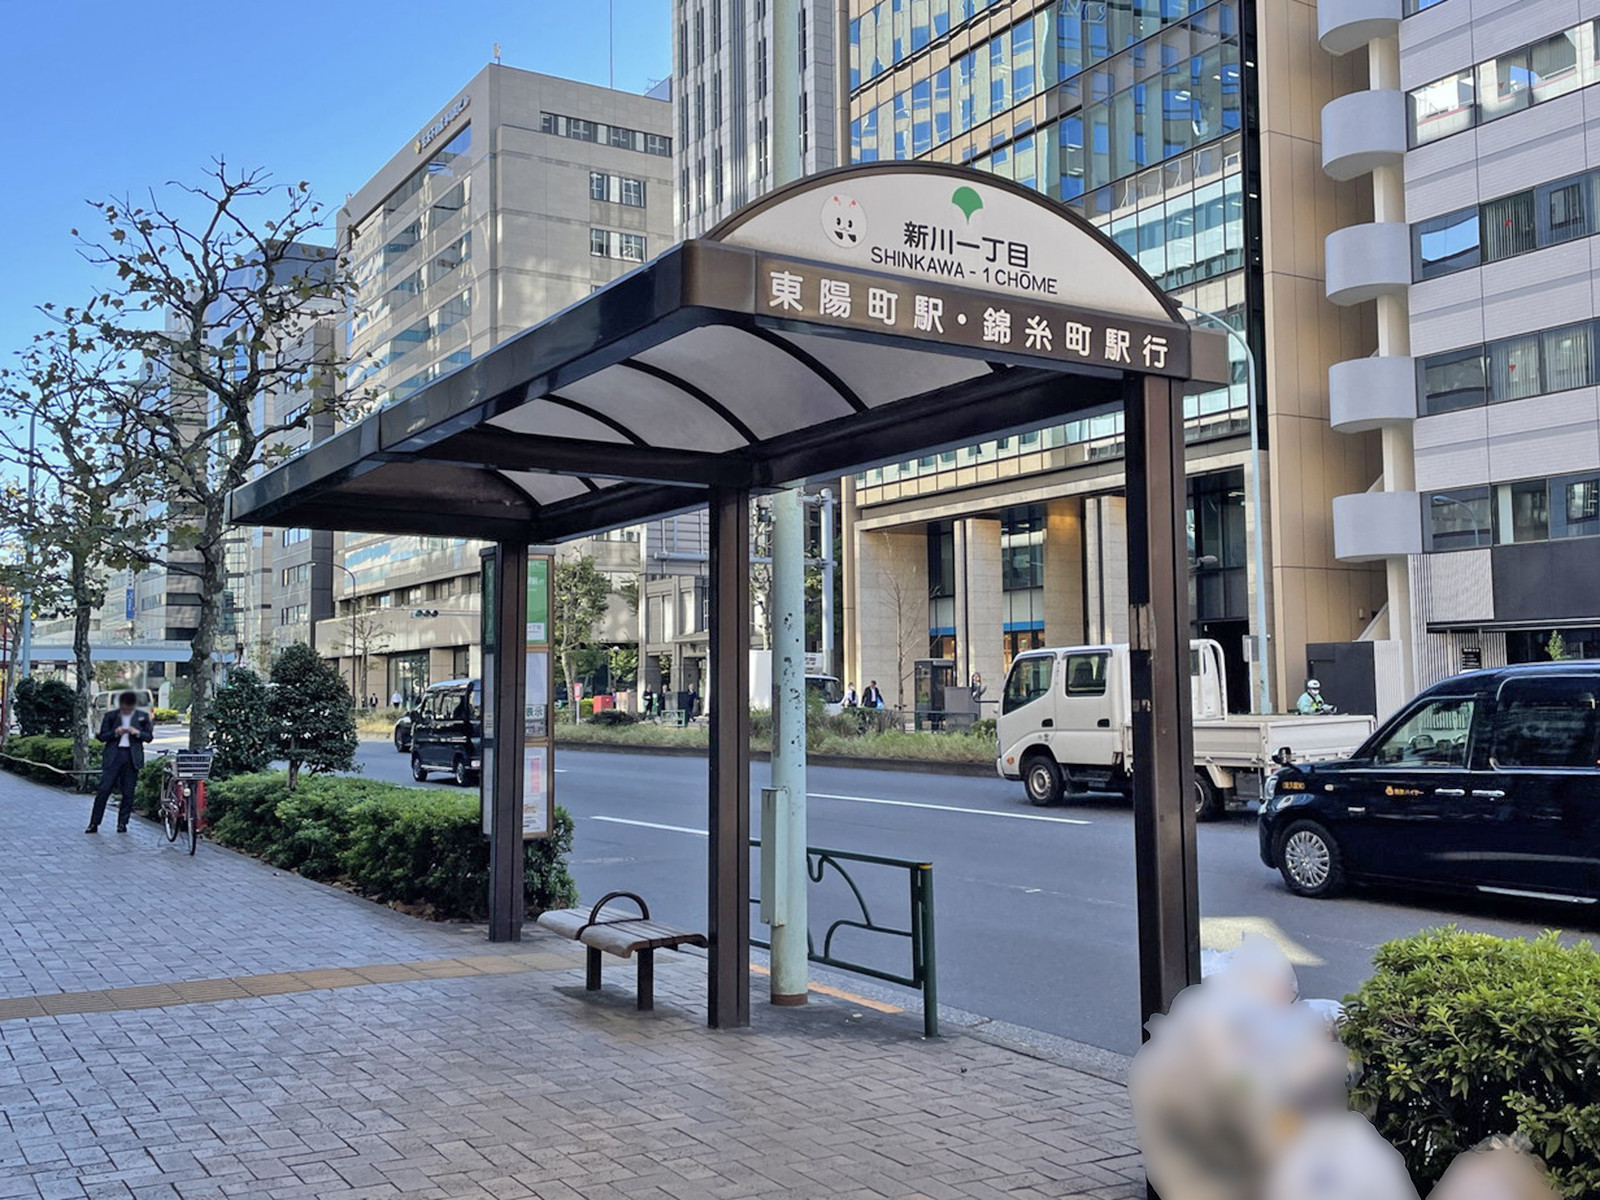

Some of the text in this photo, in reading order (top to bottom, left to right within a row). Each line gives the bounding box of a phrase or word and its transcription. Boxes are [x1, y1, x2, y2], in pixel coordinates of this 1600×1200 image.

[871, 246, 965, 279] SHINKAWA
[904, 220, 1029, 269] 新川一丁目
[769, 271, 1168, 369] 東陽町駅・錦糸町駅行
